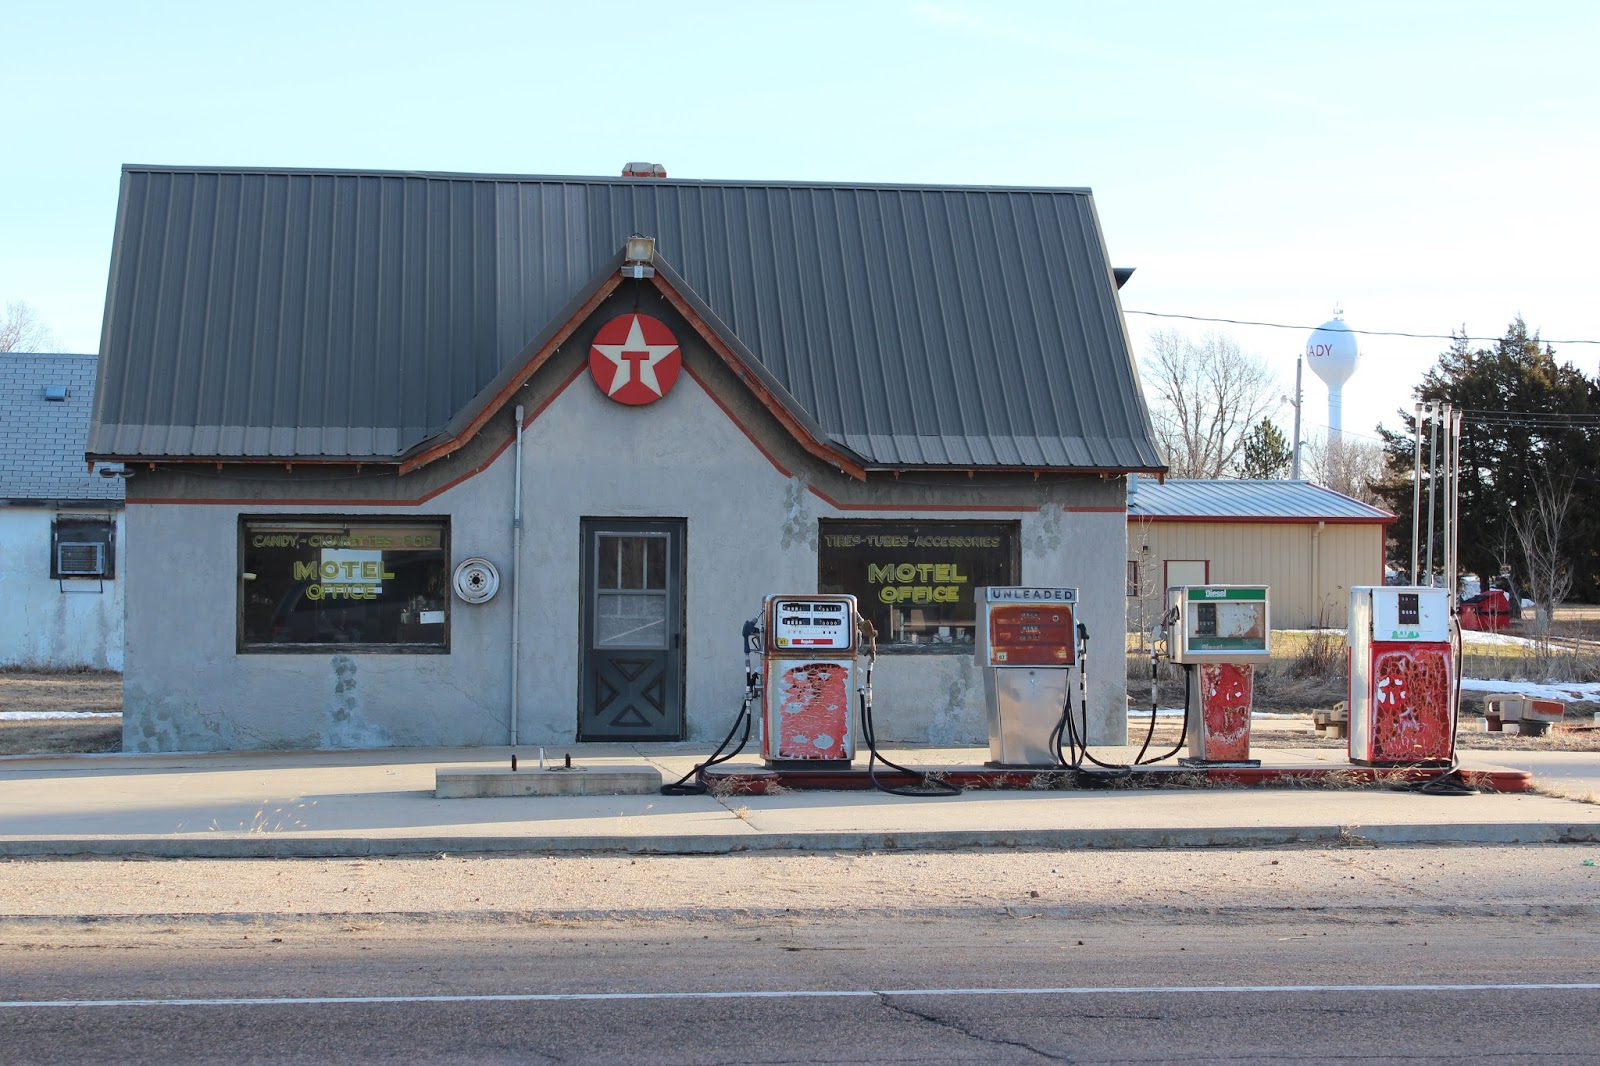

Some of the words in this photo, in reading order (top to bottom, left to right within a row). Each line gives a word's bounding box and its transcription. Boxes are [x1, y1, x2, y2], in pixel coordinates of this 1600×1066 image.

[1307, 344, 1333, 357] ADY
[621, 351, 649, 382] T
[293, 560, 395, 581] MOTEL
[868, 563, 968, 583] MOTEL
[306, 583, 378, 600] OFFICE
[878, 586, 960, 604] OFFICE
[993, 590, 1073, 600] UNLEADED
[1205, 589, 1226, 598] Diesel
